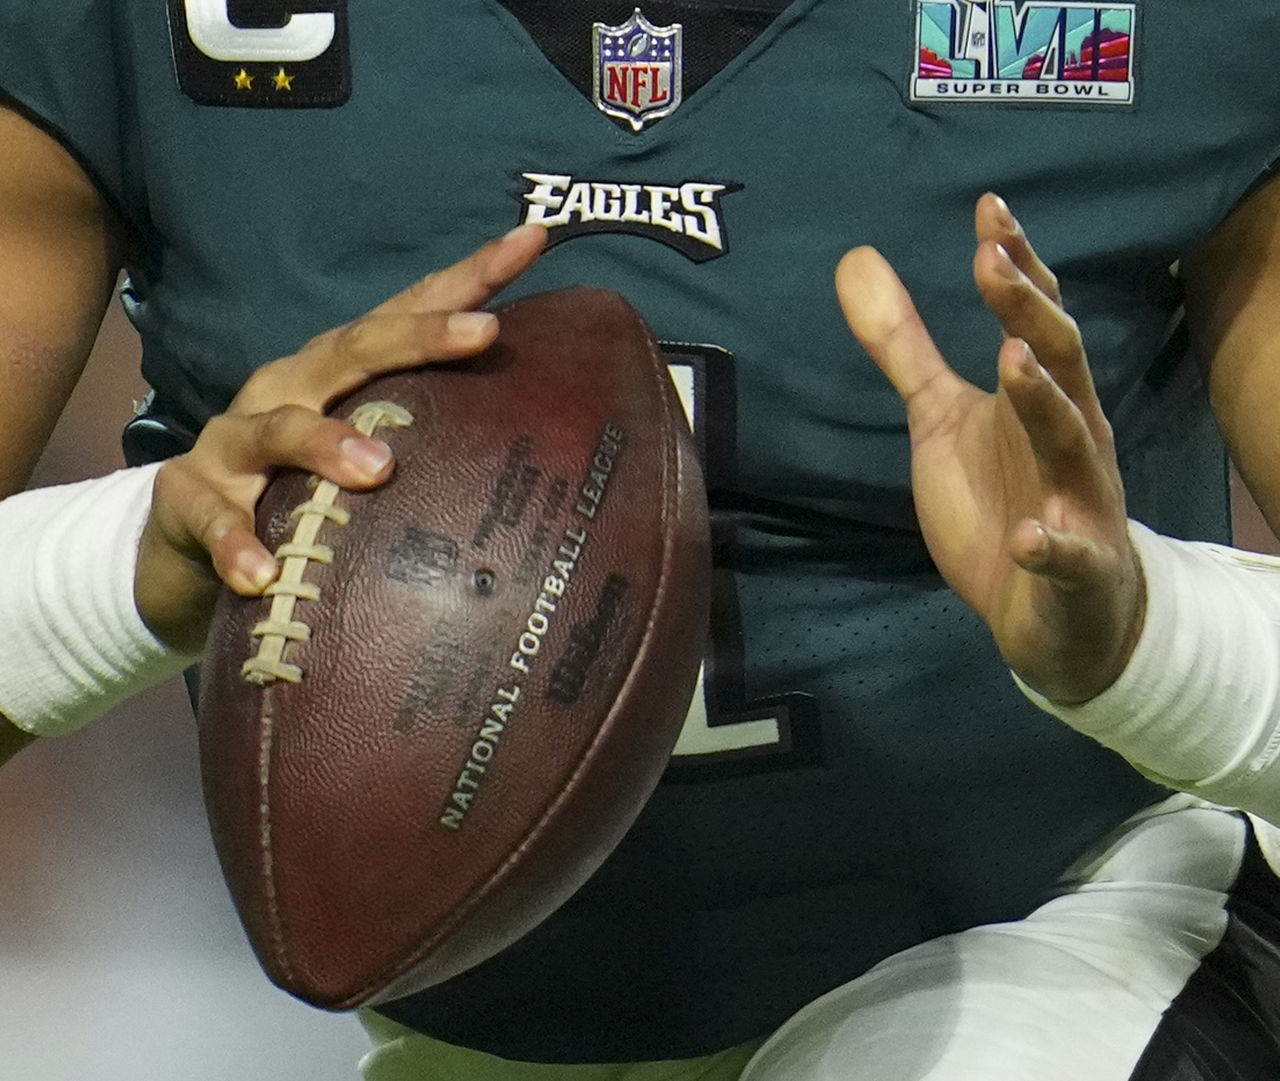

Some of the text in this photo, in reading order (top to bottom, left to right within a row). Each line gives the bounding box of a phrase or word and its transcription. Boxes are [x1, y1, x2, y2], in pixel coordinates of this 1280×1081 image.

[607, 66, 667, 108] NFL
[936, 82, 1110, 96] SUPER BOWL
[521, 172, 726, 250] EAGLES
[439, 684, 521, 830] NATIONAL
[509, 525, 587, 674] FOOTBALL
[576, 420, 624, 519] LEAGUE
